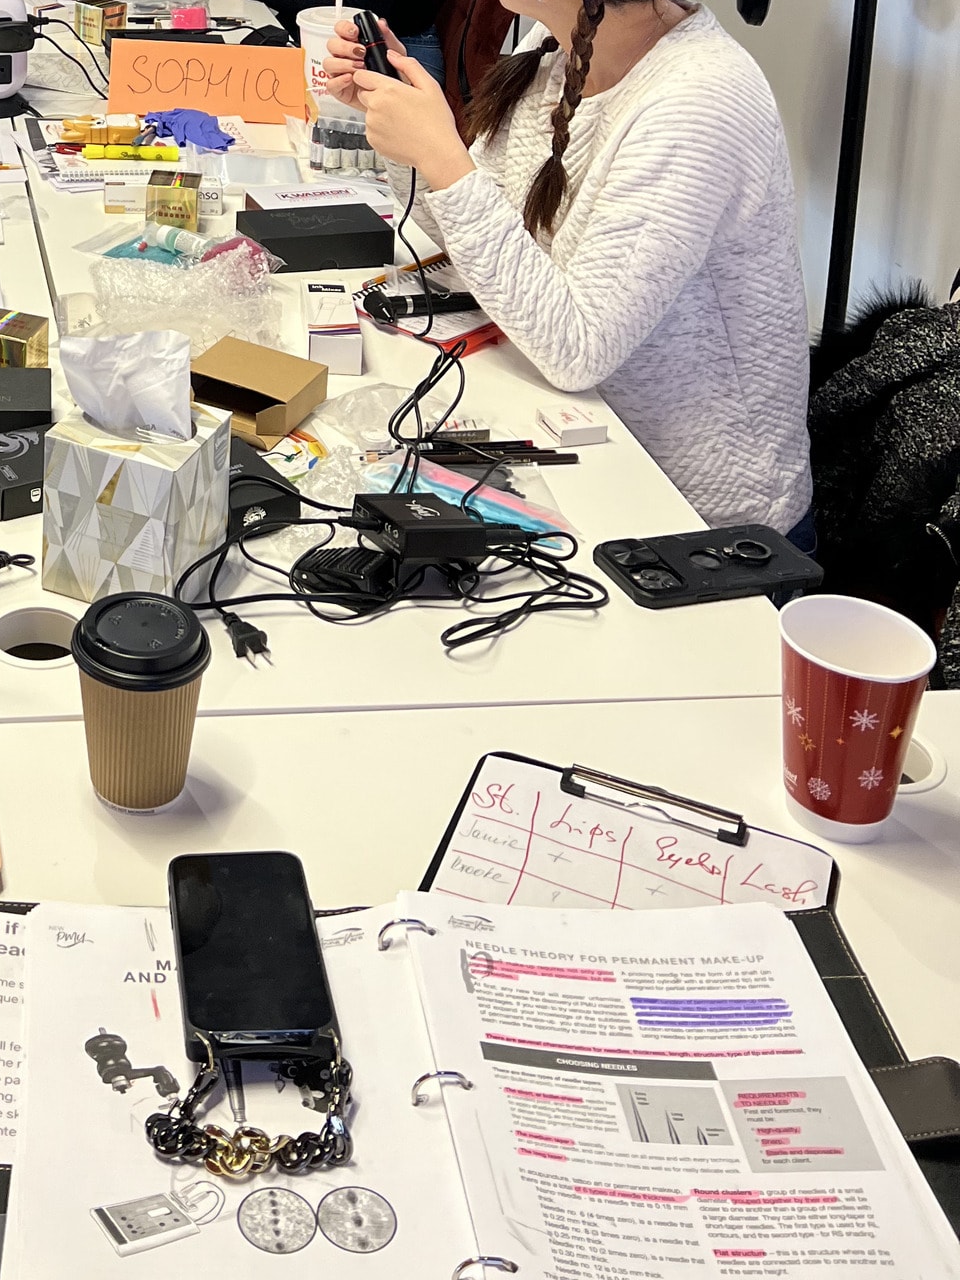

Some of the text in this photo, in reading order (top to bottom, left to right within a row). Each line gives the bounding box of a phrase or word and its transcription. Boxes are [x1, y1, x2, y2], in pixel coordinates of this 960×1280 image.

[281, 189, 349, 199] KWADRON
[459, 820, 526, 850] Jamie
[550, 804, 617, 848] Lips
[741, 863, 818, 904] Lash
[6, 921, 18, 934] if
[465, 940, 764, 966] NEEDLE THEORY FOR PERMANENT MAKE-UP
[124, 972, 166, 983] AND
[486, 1033, 505, 1041] There
[518, 1038, 541, 1046] several
[543, 1042, 590, 1052] characteristics
[556, 1058, 638, 1071] CHOOSING NEEDLES
[763, 1197, 792, 1205] together
